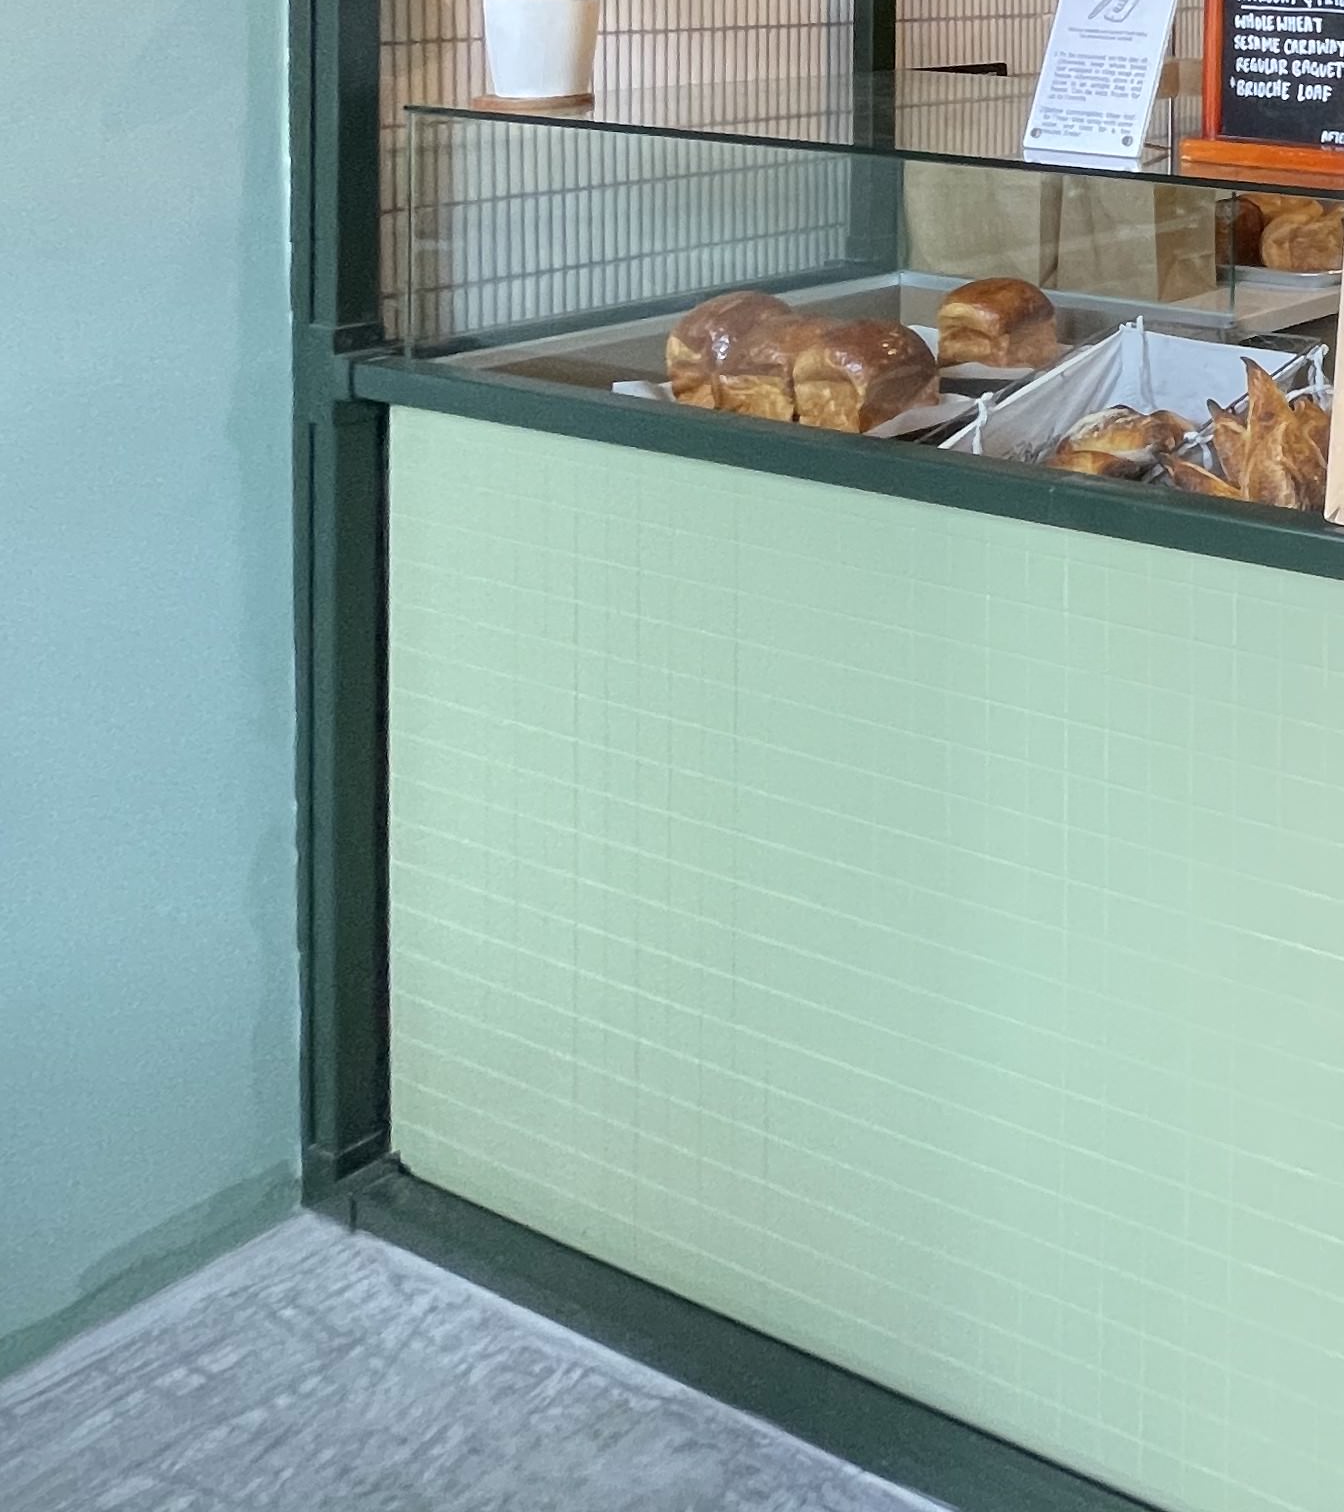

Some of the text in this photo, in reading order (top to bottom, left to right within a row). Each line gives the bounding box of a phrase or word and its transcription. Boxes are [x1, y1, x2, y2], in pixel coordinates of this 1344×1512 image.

[1234, 13, 1322, 33] WHOLE WHEAT
[1234, 35, 1280, 54] SESAME
[1236, 57, 1288, 76] REGULAR
[1237, 79, 1332, 102] BRIOCHE LOAF
